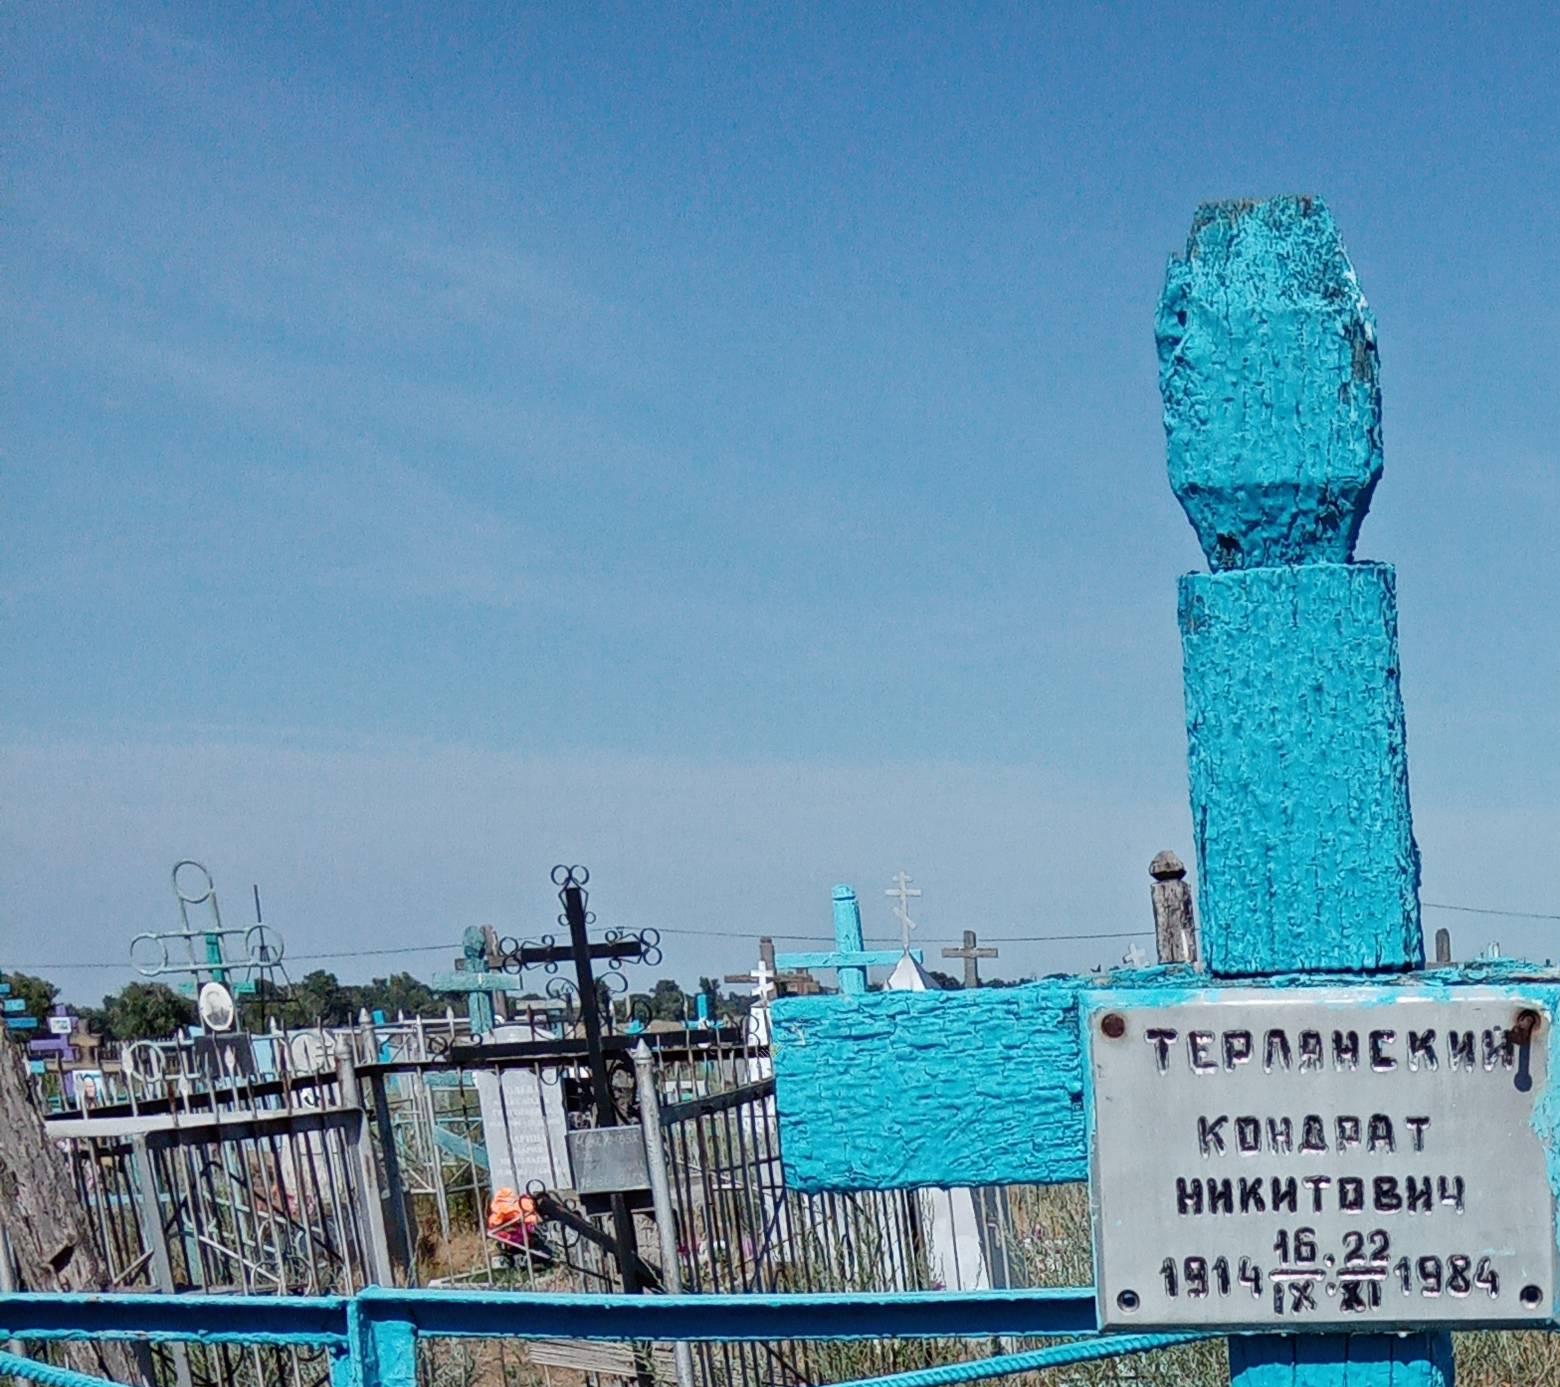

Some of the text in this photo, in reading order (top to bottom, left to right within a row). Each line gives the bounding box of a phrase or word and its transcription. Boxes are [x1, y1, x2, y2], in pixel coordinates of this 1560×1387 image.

[1144, 1026, 1517, 1076] ТЕРЛЯНСКИЙ
[1197, 1114, 1431, 1159] КОНДРАТ
[1175, 1174, 1467, 1216] НИКИТОВИЧ
[1159, 1254, 1500, 1300] 1914 1984
